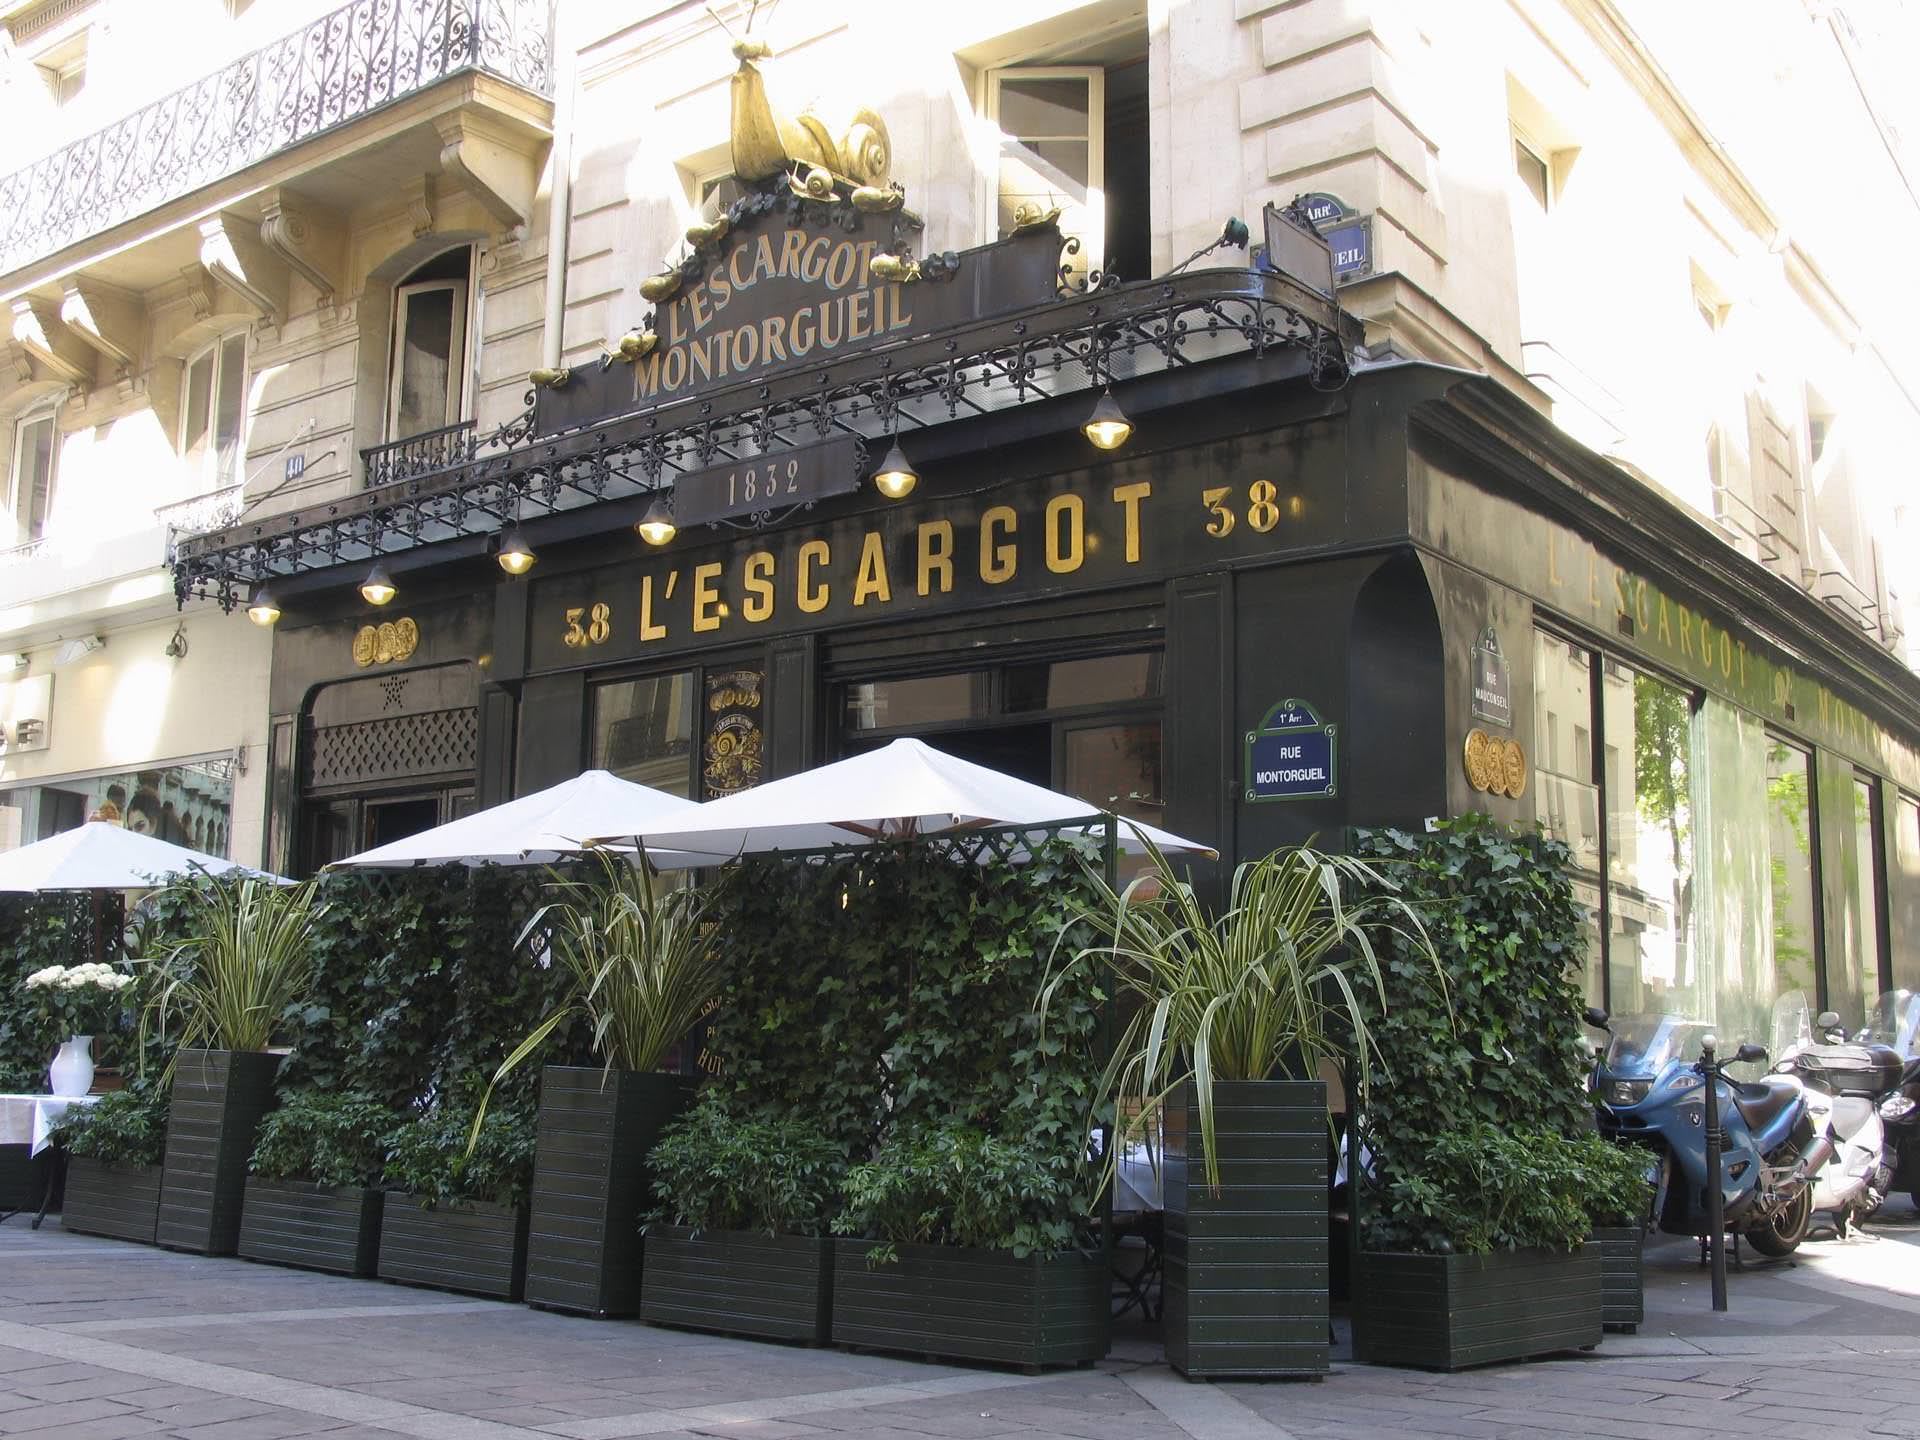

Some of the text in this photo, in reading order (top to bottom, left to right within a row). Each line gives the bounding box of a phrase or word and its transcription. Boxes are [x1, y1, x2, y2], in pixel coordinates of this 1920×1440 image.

[667, 229, 878, 346] L'ESCARGOT
[632, 285, 913, 401] MONTORGUEIL
[729, 460, 798, 505] 1832
[564, 480, 1280, 647] 38 L'ESCARGOT 38
[1256, 768, 1326, 784] MONTORGUEIL
[1280, 746, 1301, 759] RUE
